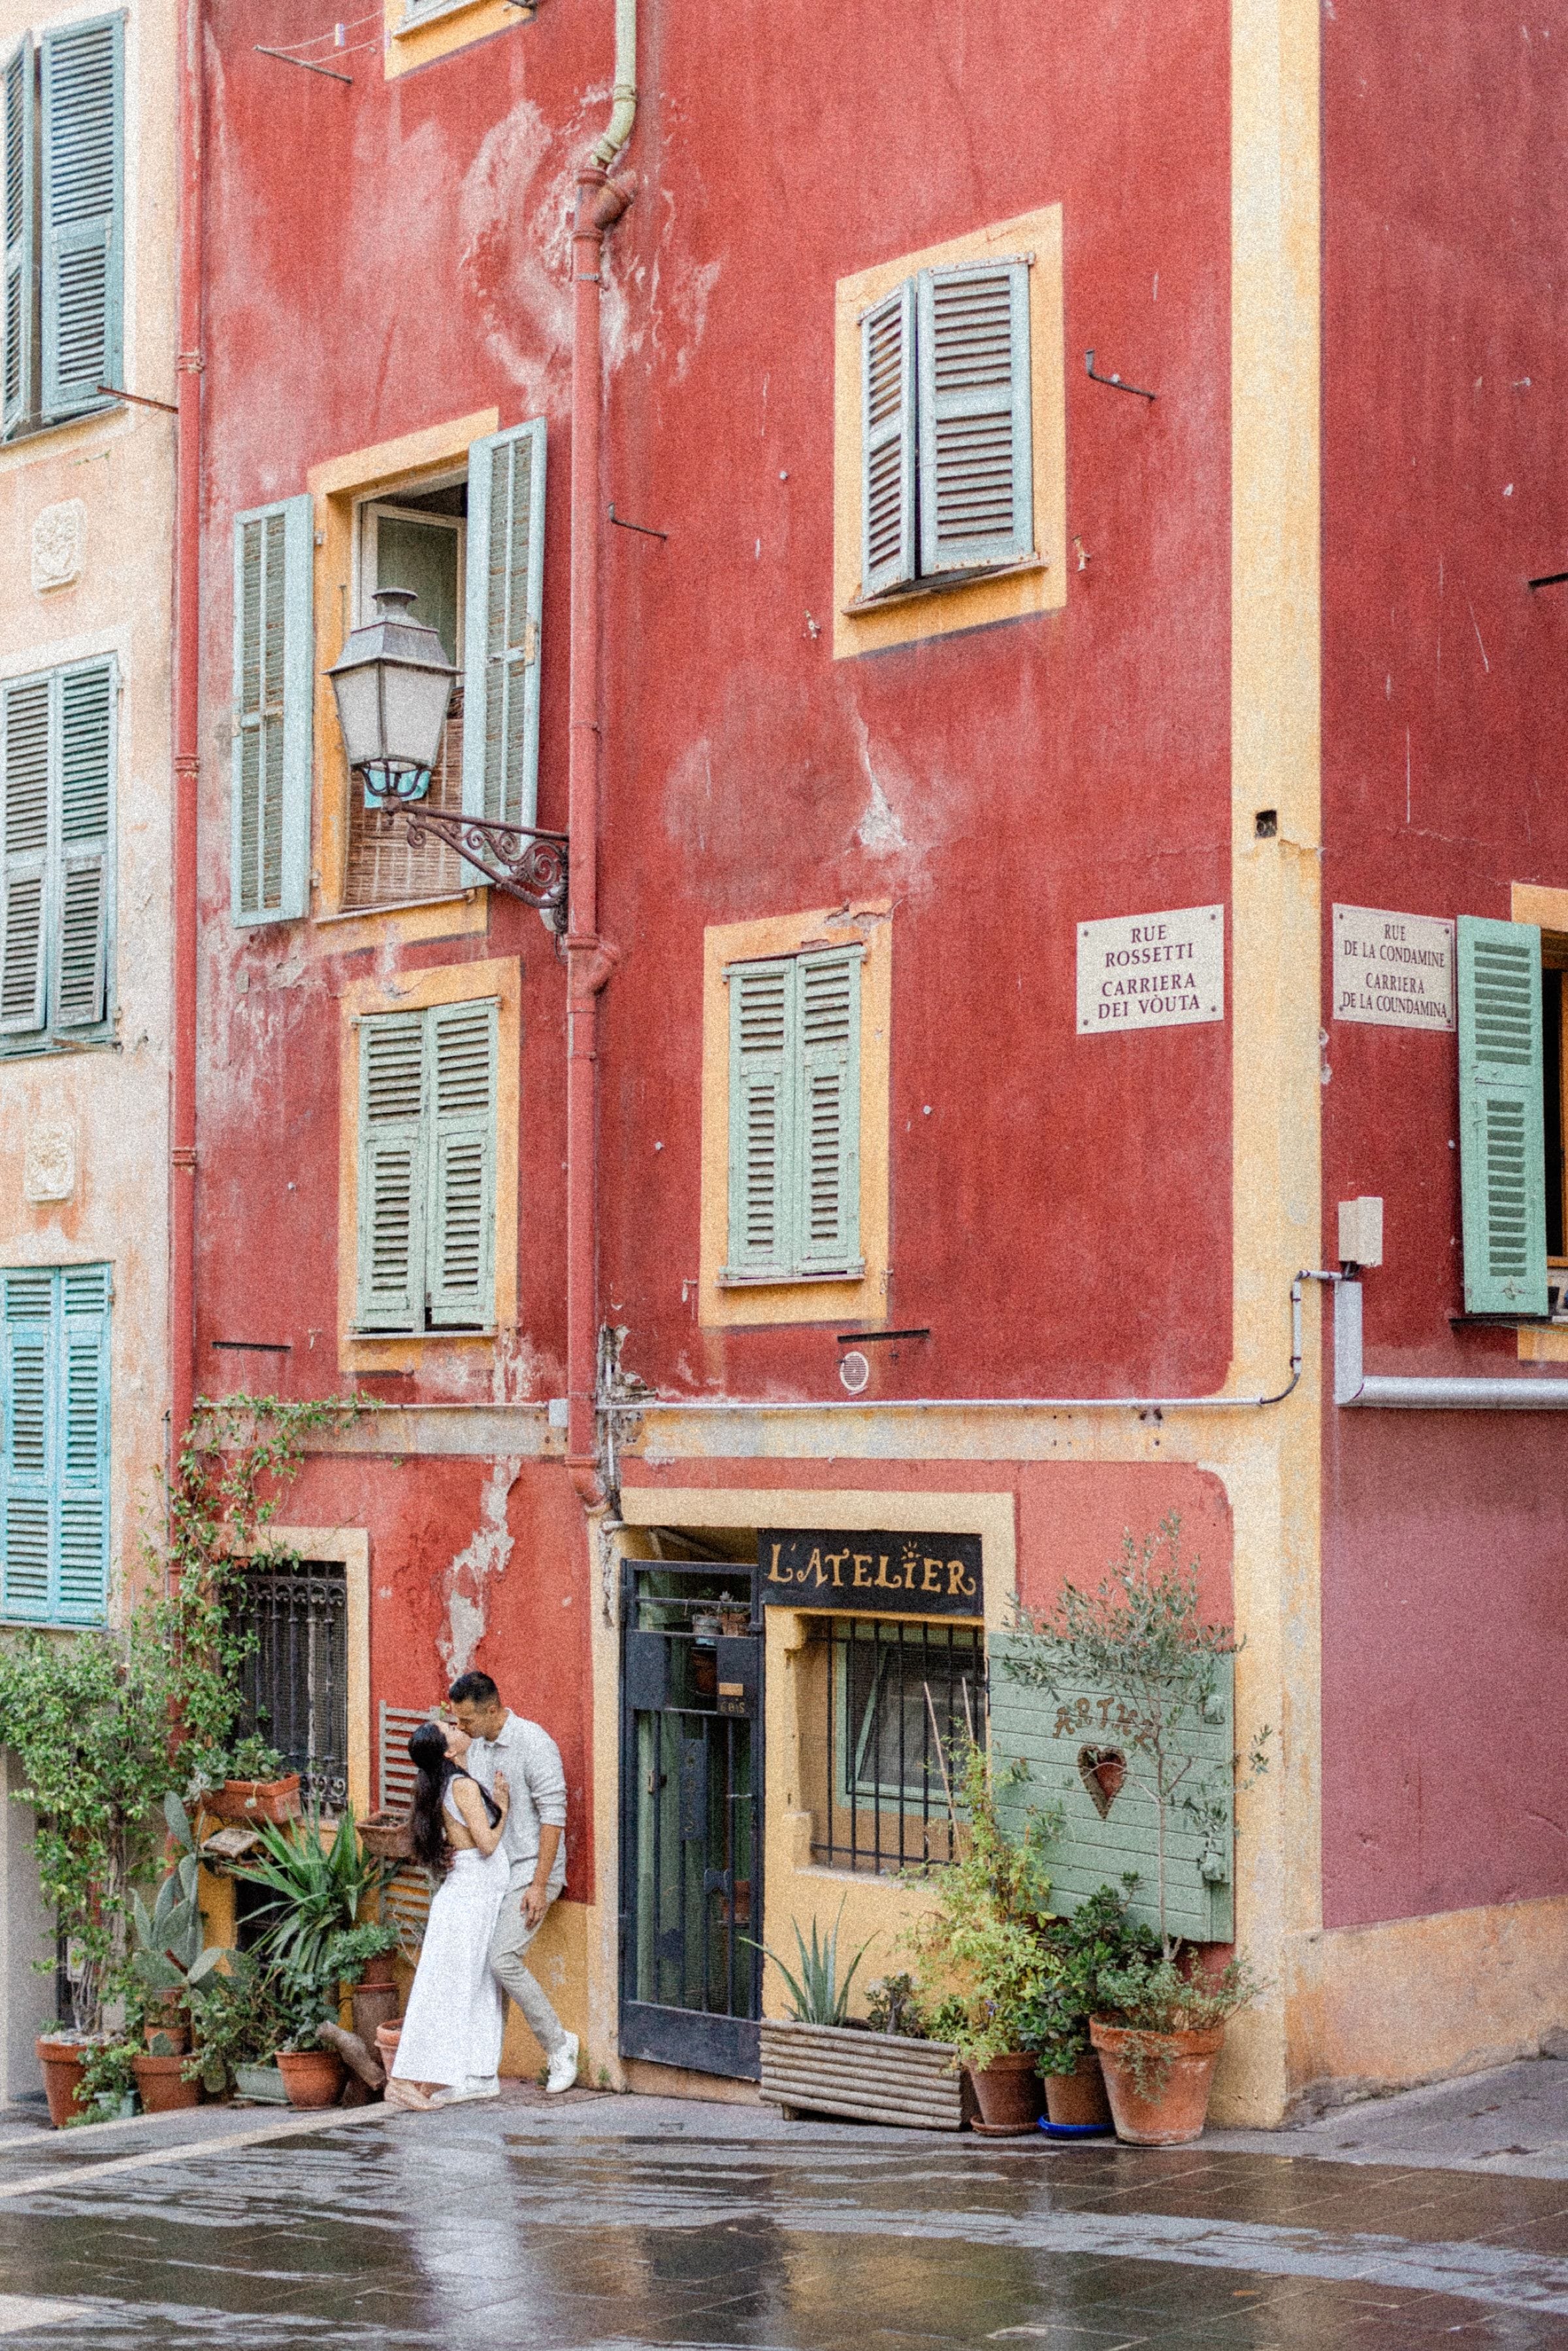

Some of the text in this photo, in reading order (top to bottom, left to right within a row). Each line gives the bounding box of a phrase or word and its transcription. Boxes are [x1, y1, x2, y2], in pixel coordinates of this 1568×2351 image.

[1131, 925, 1167, 943] RUE
[1384, 924, 1406, 941] RUE
[1105, 943, 1194, 968] ROSSETTI
[1344, 940, 1445, 968] DE LA CONDAMINE
[1102, 972, 1196, 997] CARRIERA
[1365, 972, 1425, 995] CARRIERA
[1098, 1001, 1128, 1019] DEI
[1342, 991, 1447, 1018] DE LA COUNDAMINA
[767, 1541, 977, 1596] L'ATELIER
